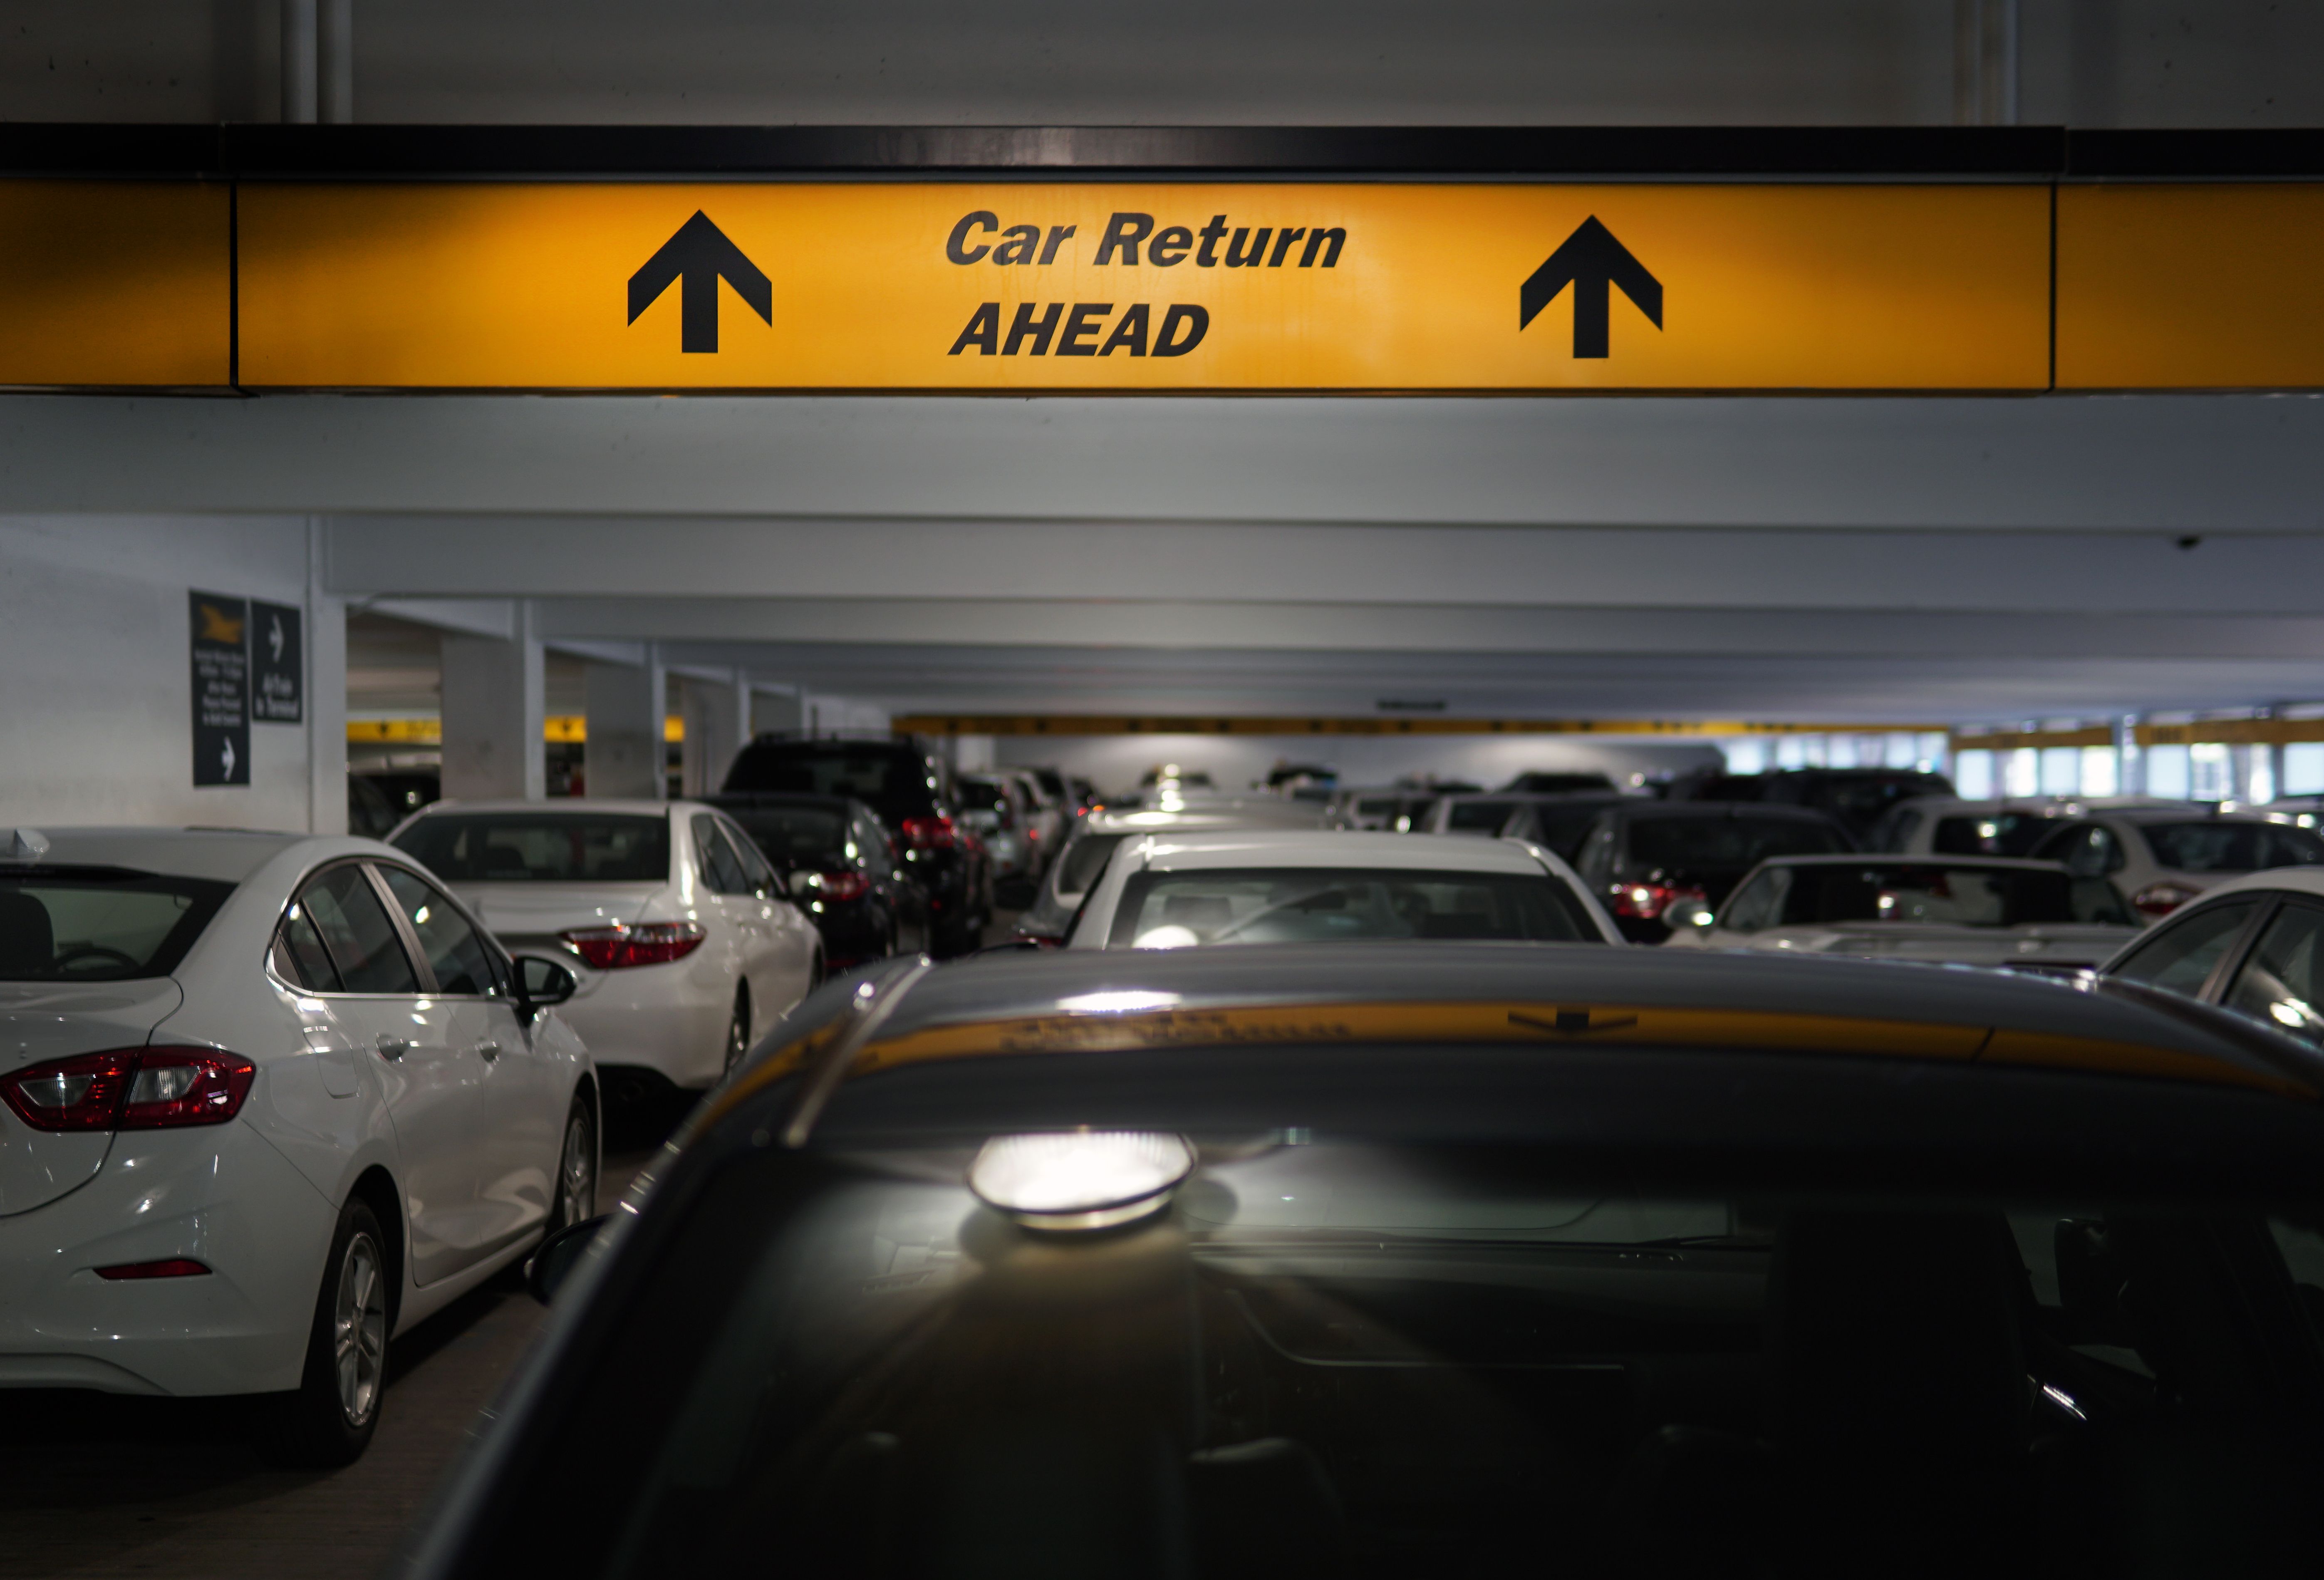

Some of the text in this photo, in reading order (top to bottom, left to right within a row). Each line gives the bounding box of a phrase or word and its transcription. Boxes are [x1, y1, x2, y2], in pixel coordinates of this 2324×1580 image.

[946, 210, 1347, 268] Car Return
[946, 302, 1210, 357] AHEAD
